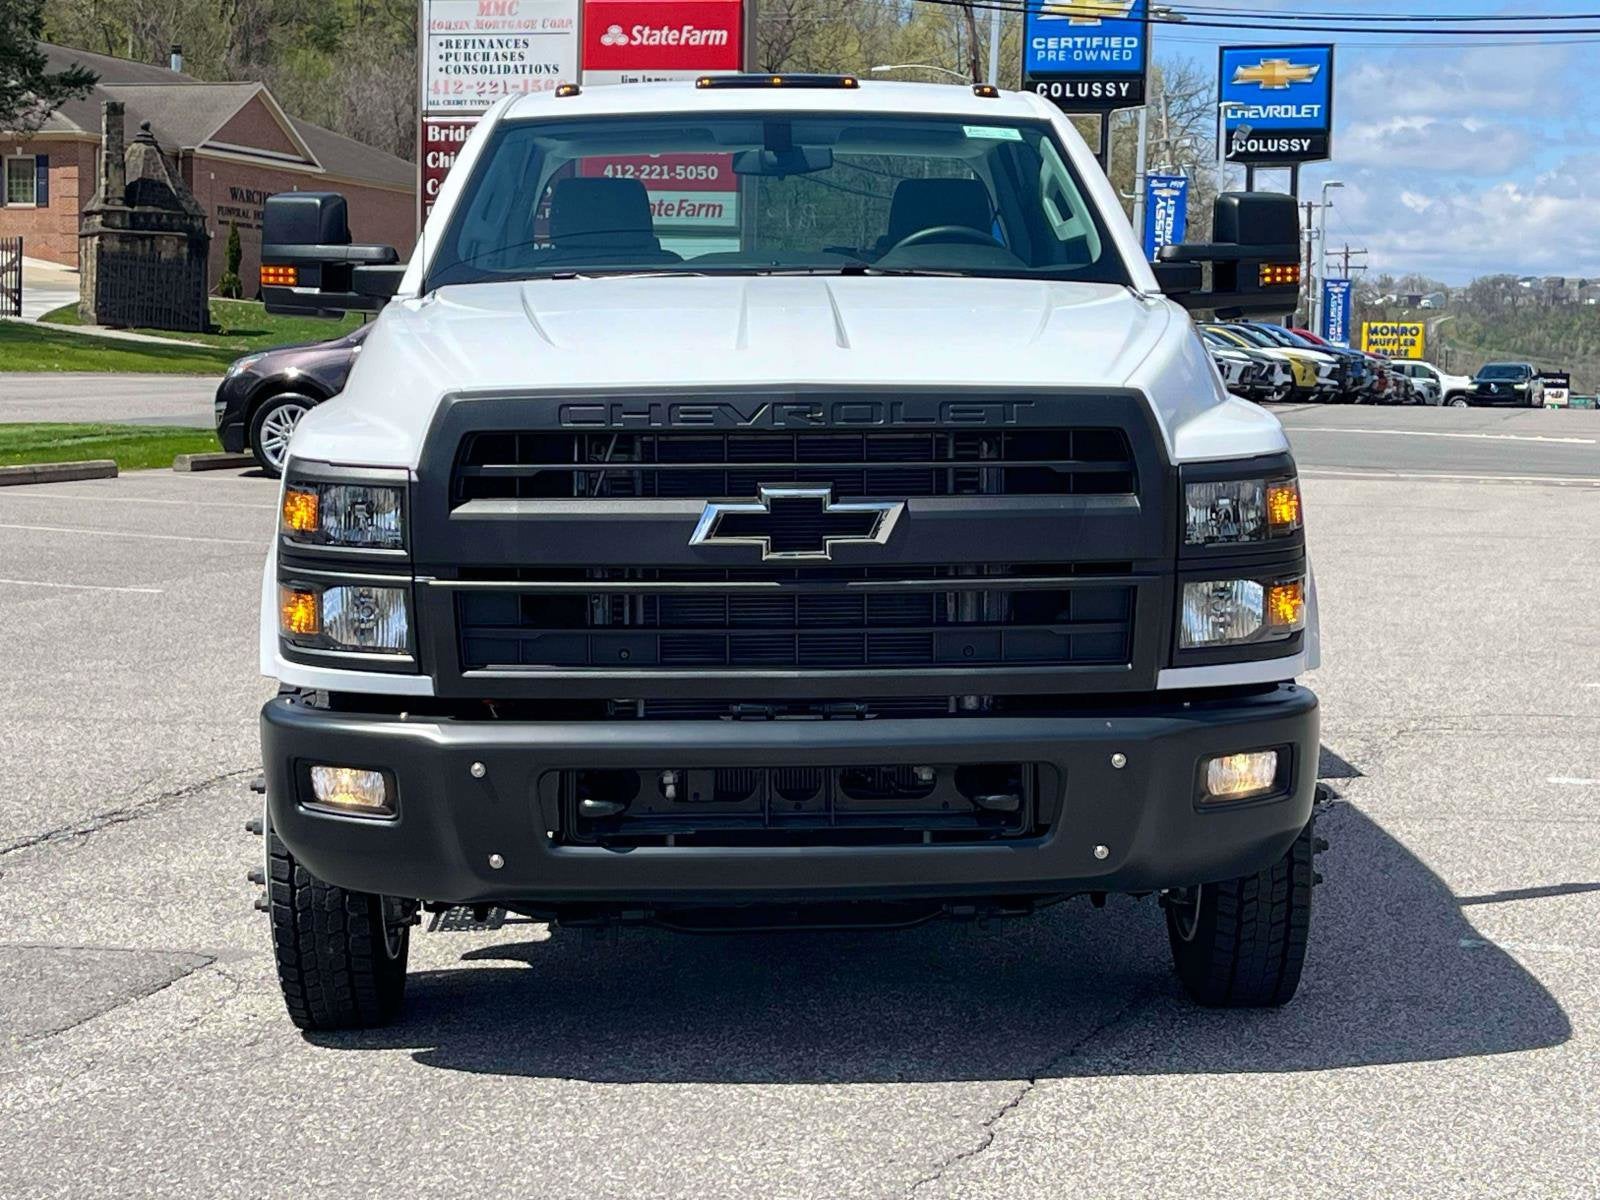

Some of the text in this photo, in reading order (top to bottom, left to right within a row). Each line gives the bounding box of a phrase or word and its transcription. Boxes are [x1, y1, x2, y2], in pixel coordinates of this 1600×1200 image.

[474, 19, 538, 30] MORTGAGE
[1032, 37, 1138, 49] CERTIFIED
[1036, 82, 1130, 97] COLUSSY
[1236, 138, 1311, 152] COLUSSY
[603, 164, 718, 180] 412-221-5050
[1369, 325, 1420, 337] MONRO
[1369, 338, 1416, 347] MUFFLER
[558, 402, 1036, 427] CHEVROLET
